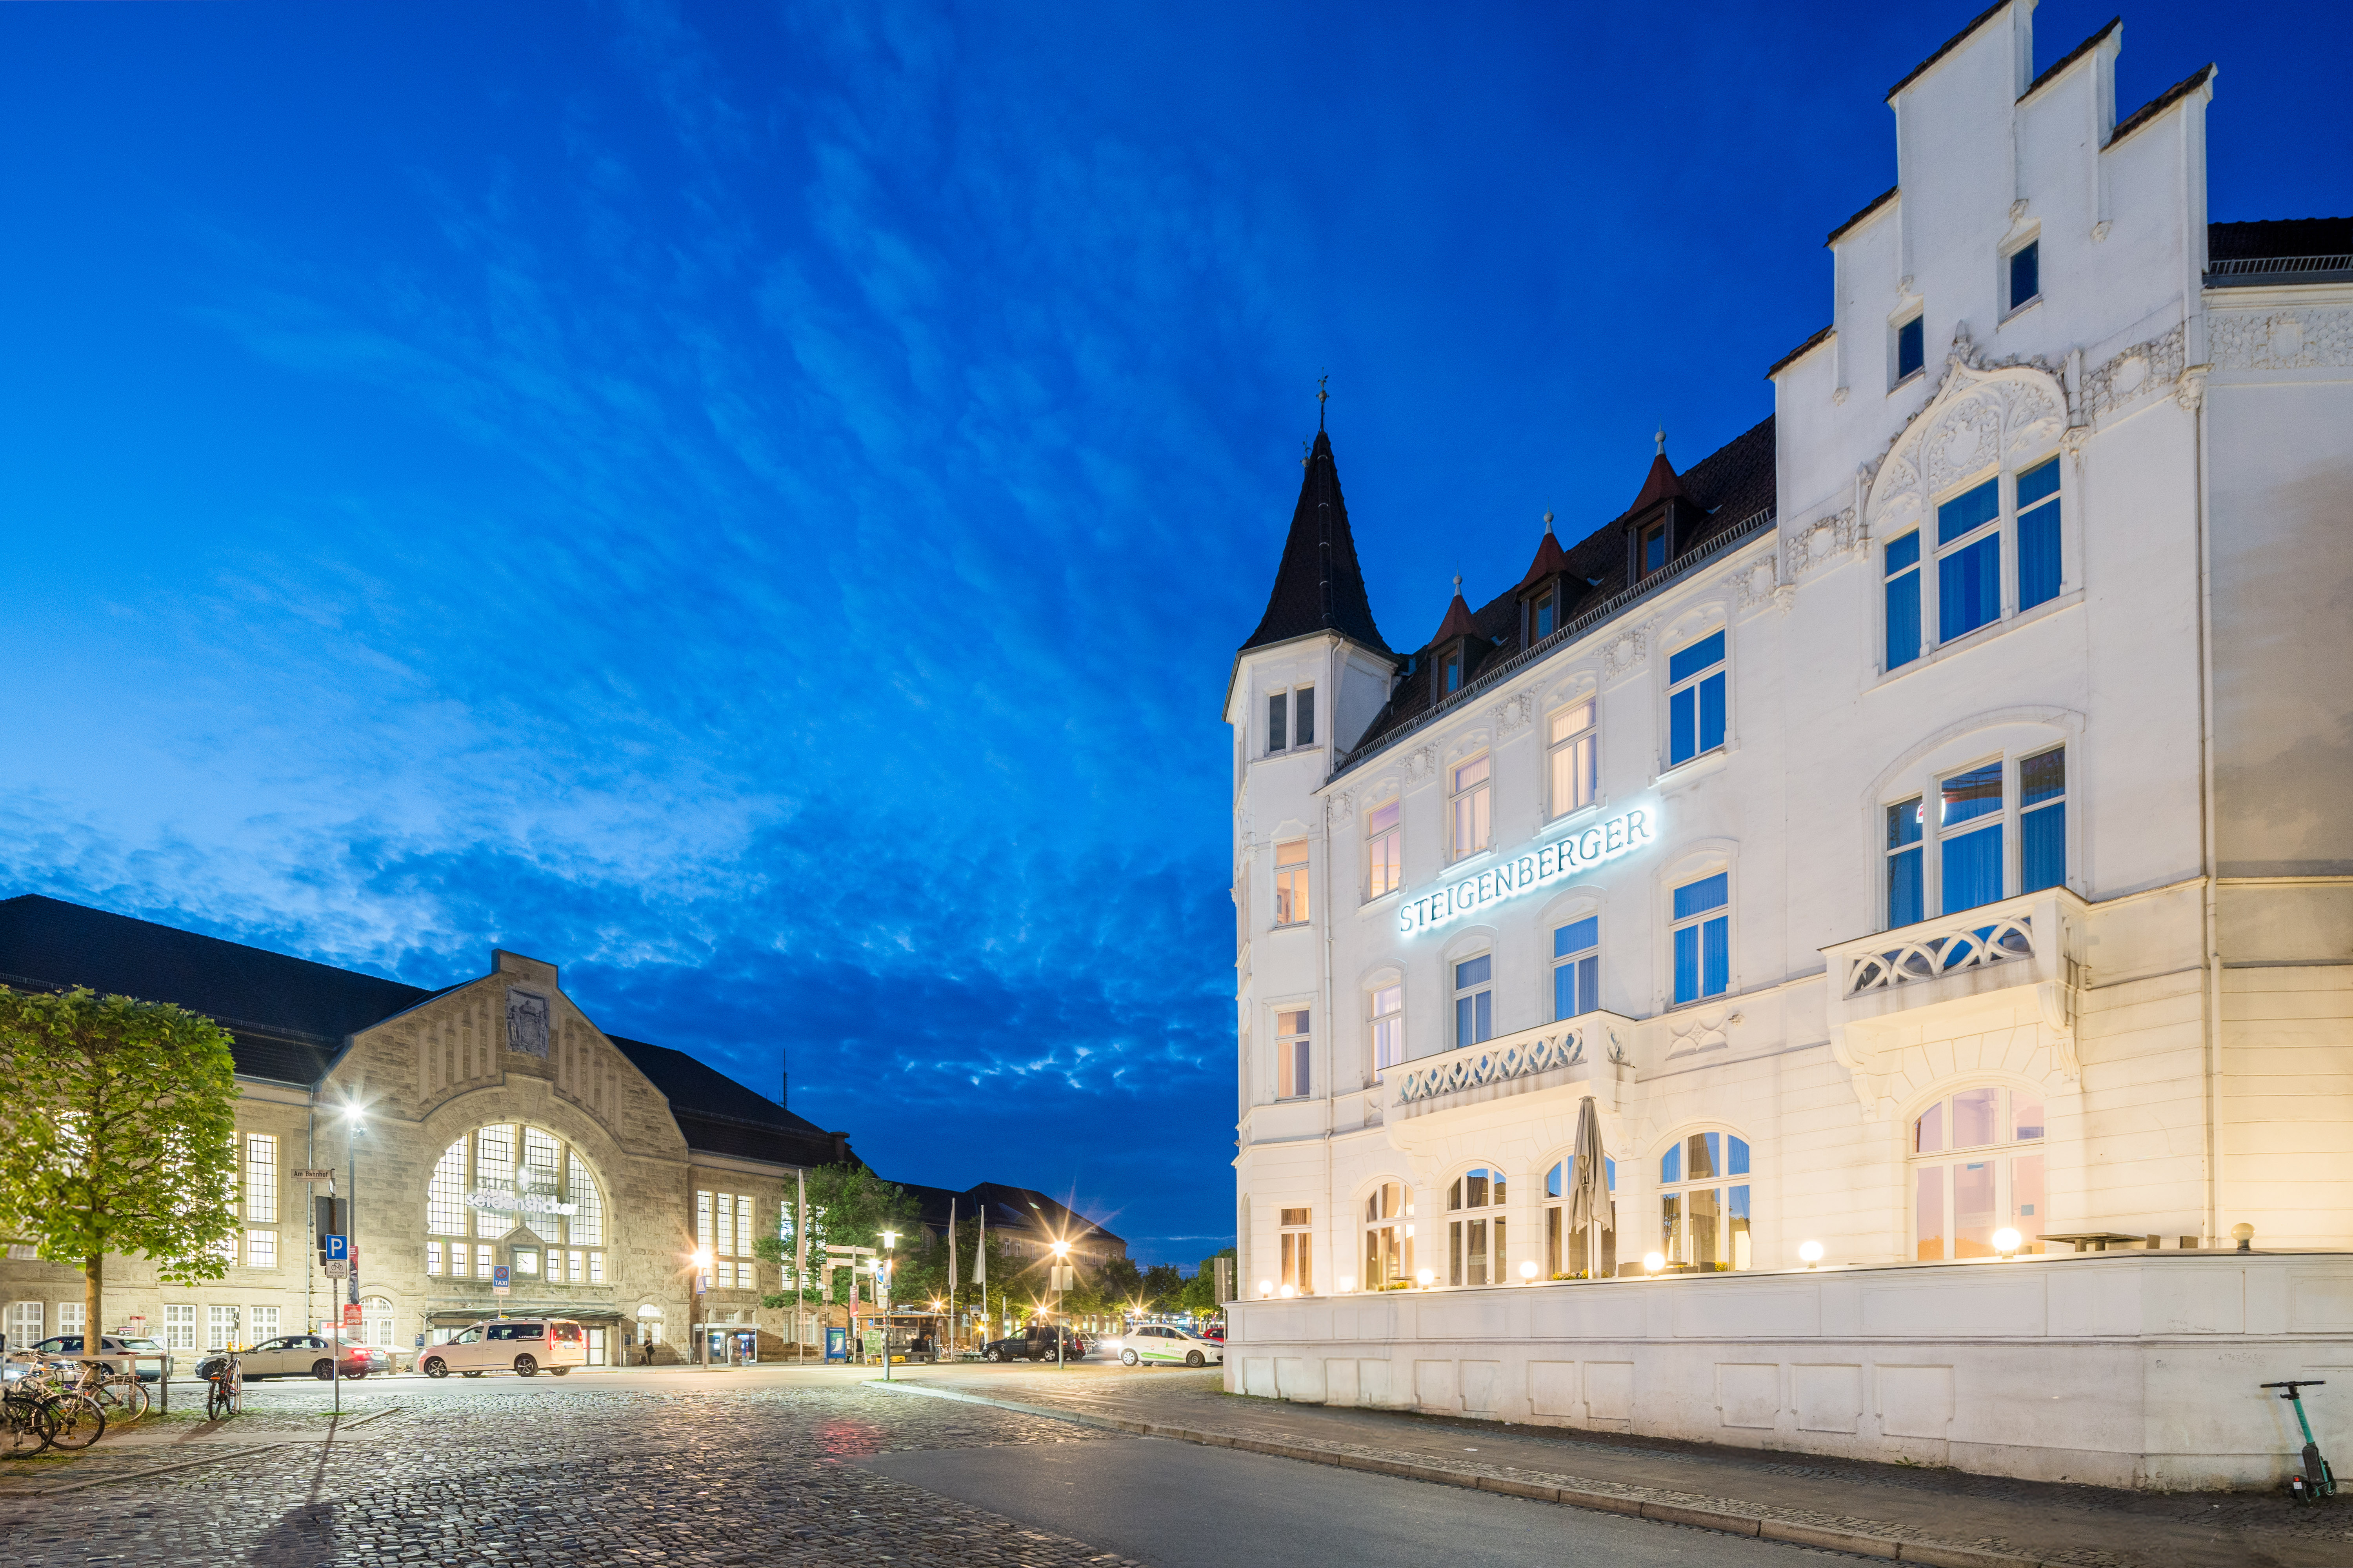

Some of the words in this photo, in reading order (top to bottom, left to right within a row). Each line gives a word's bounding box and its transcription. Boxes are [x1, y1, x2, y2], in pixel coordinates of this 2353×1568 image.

[1400, 810, 1649, 932] STEIGENBERGER
[466, 1190, 578, 1215] seidensticker
[331, 1238, 343, 1257] P
